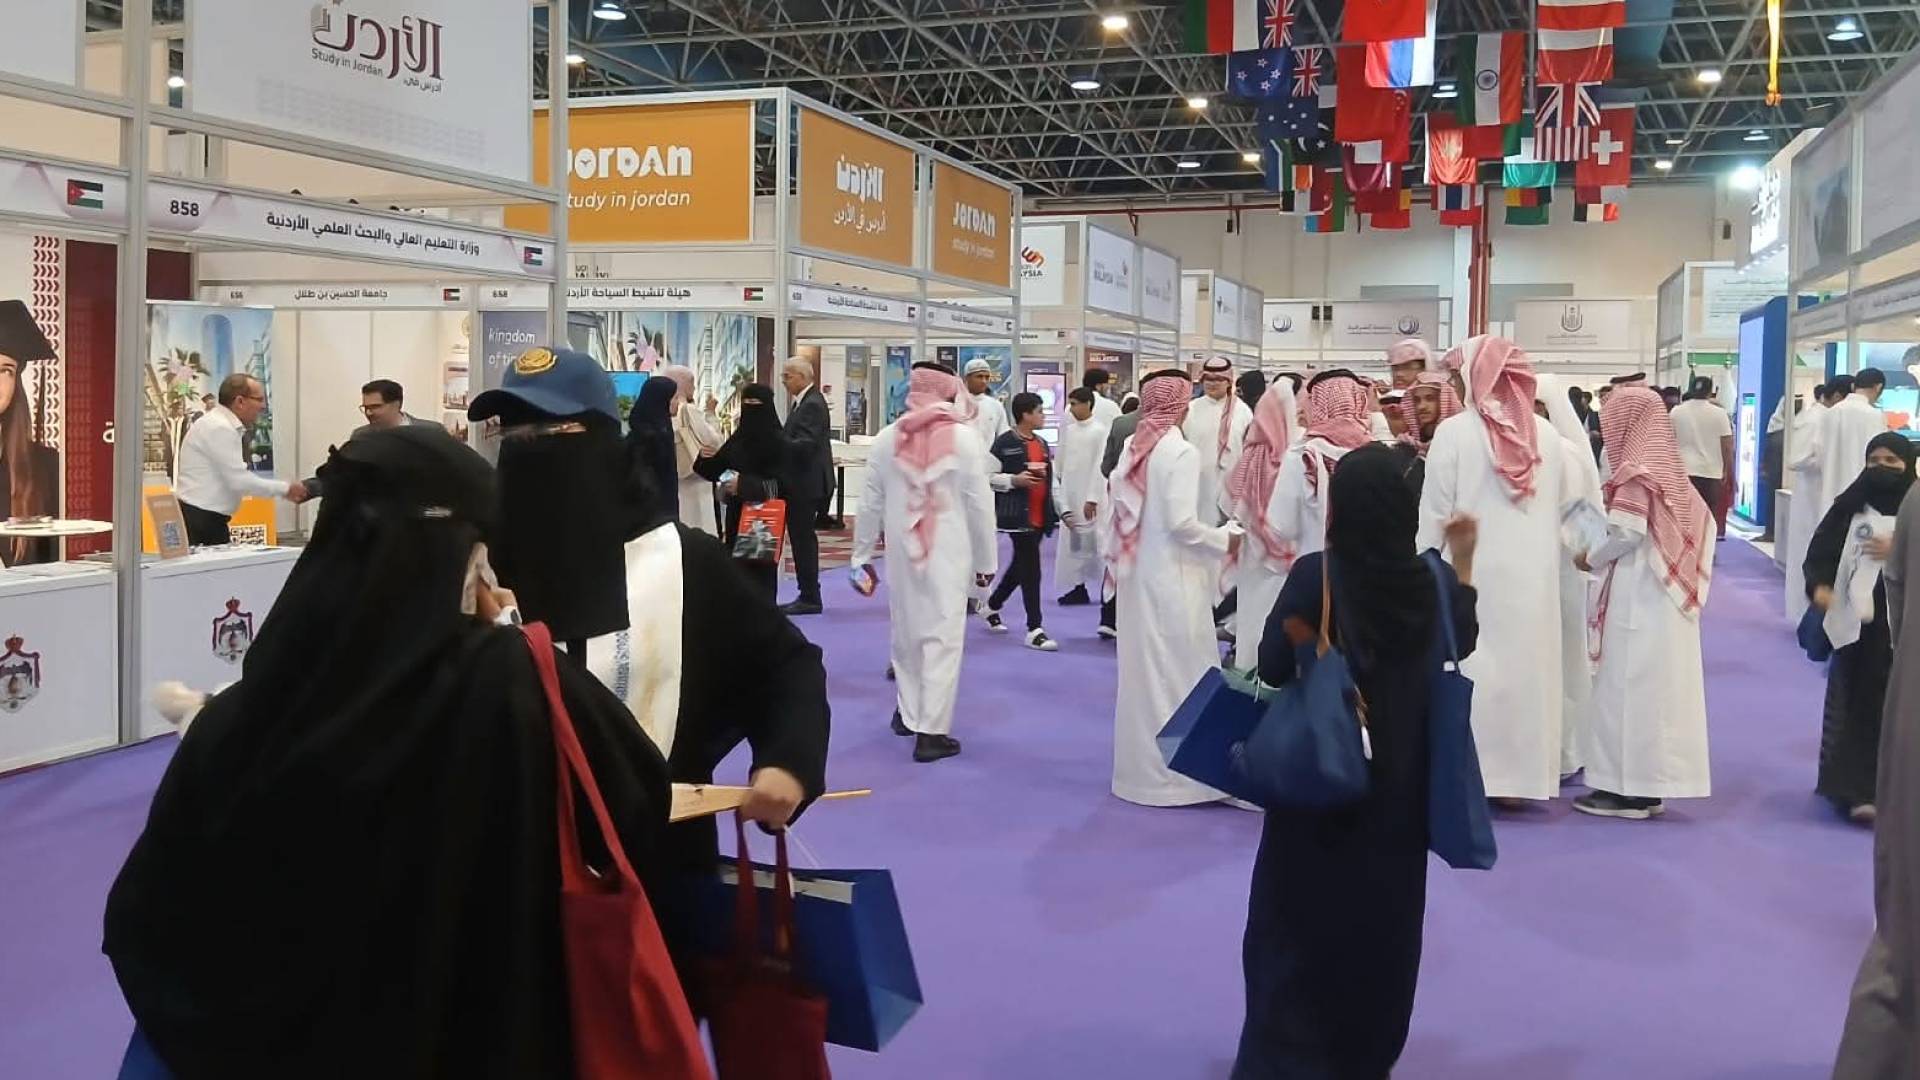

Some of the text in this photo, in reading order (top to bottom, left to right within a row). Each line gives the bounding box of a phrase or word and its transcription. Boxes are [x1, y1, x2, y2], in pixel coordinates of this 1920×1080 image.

[310, 0, 445, 81] الأردن
[311, 48, 383, 77] Study in Jordan
[169, 199, 200, 217] 858
[567, 188, 691, 212] tudy in jordan
[266, 211, 480, 256] وزارة التعليم العالي والبحث العلمي الأردنية
[294, 288, 388, 301] جامعة الحسين بن طلال
[591, 286, 630, 300] السياحة
[631, 286, 665, 300] تنشيط
[666, 287, 692, 300] هيئة
[488, 327, 535, 345] kingdom
